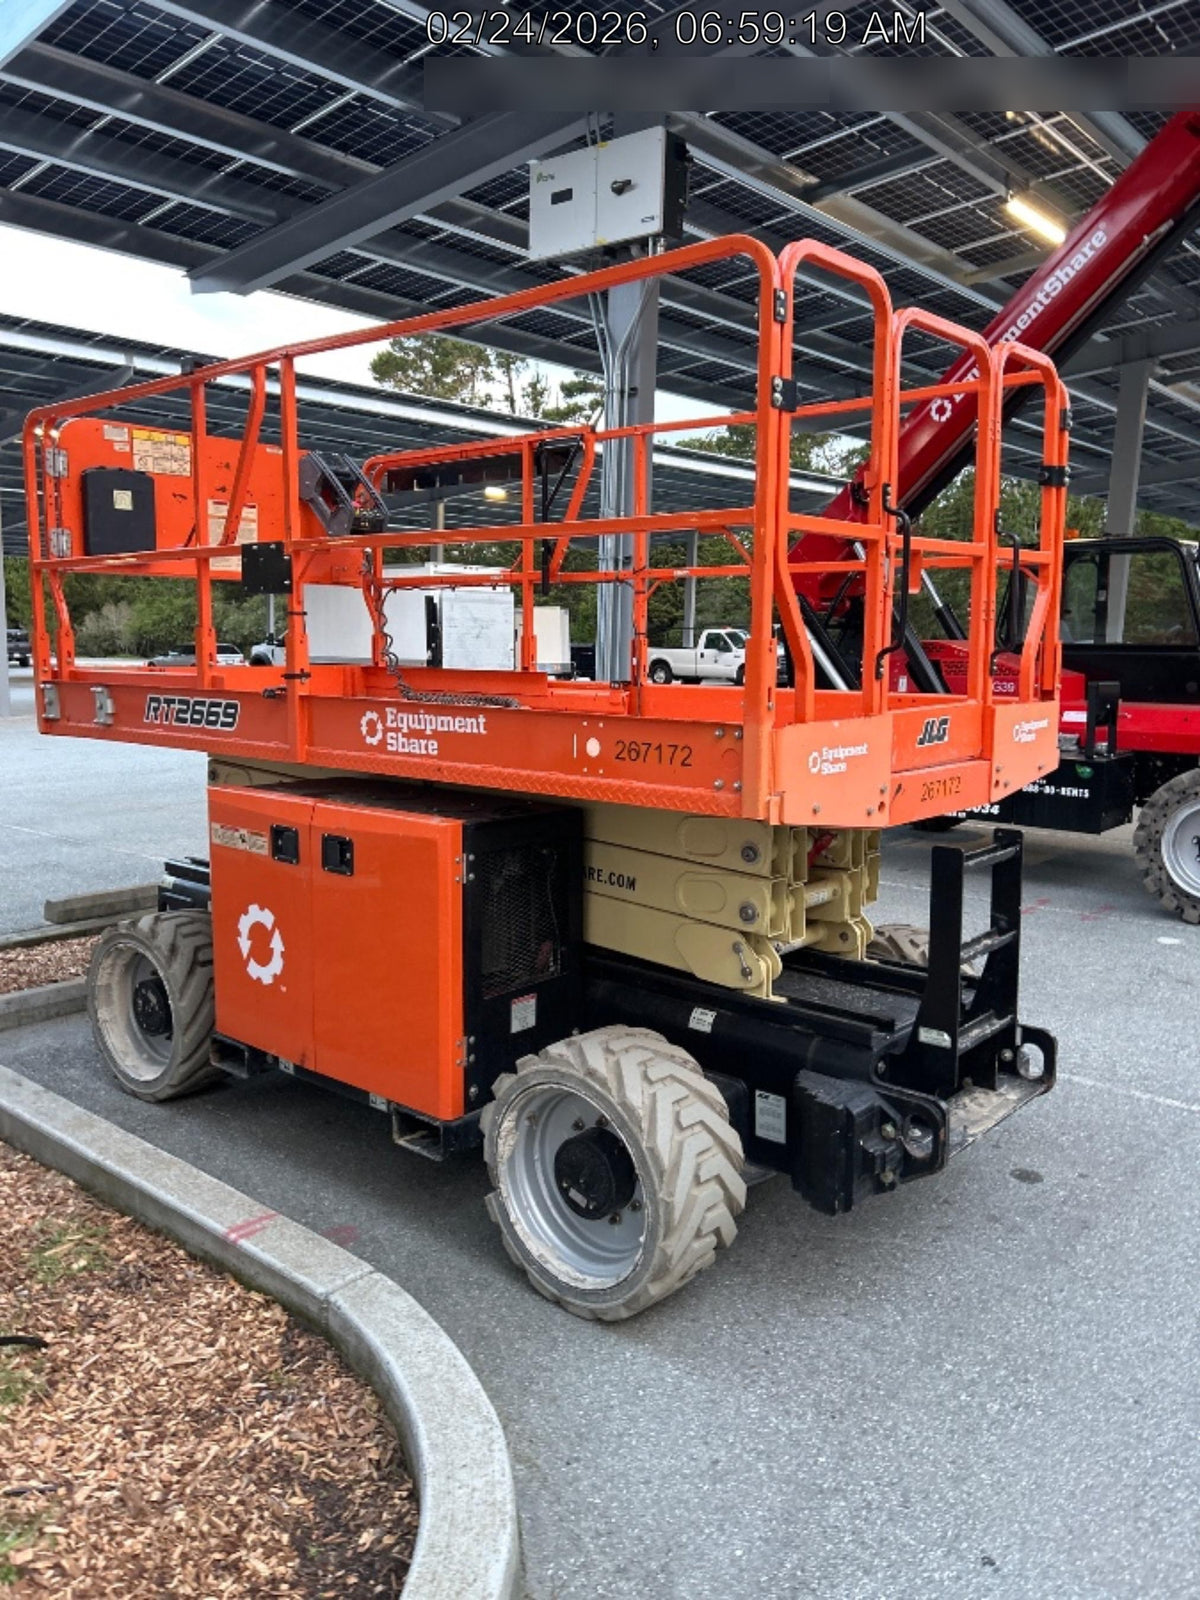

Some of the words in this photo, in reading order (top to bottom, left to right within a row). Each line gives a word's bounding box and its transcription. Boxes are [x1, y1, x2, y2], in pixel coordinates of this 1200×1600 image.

[143, 694, 241, 732] RT2669
[385, 707, 487, 735] Equipment
[385, 731, 439, 756] Share
[916, 716, 951, 748] JLG
[614, 740, 693, 768] 267172
[821, 742, 869, 762] Equipment
[821, 761, 848, 775] Share
[920, 775, 962, 803] 267172
